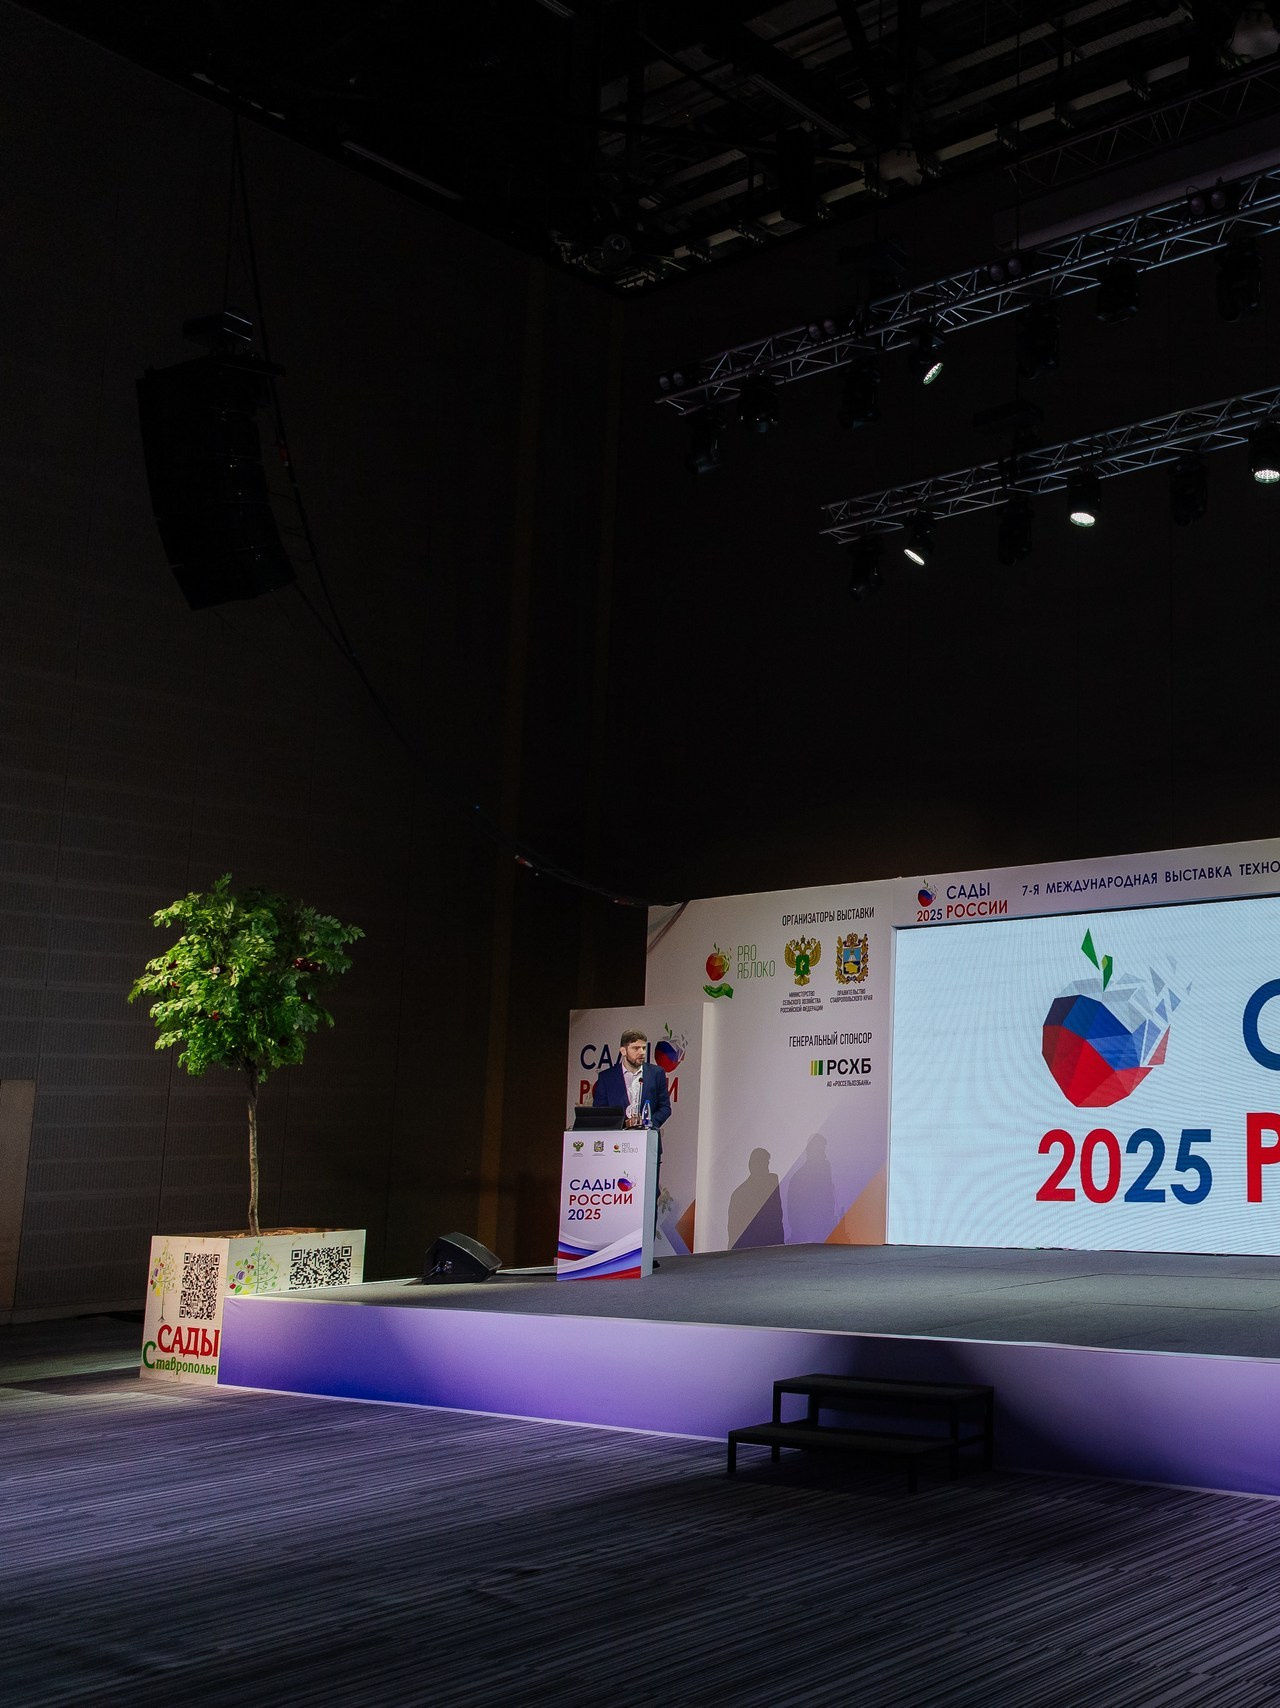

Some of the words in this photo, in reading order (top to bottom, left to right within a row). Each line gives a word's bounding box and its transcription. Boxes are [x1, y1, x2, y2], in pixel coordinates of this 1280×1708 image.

[1021, 884, 1040, 897] 7-Я
[1046, 872, 1158, 894] МЕЖДУНАРОДНАЯ
[1164, 864, 1233, 883] ВЫСТАВКА
[946, 882, 991, 900] САДЫ
[782, 911, 835, 926] ОРГАНИЗАТОРЫ
[837, 907, 875, 921] ВЫСТАВКИ
[916, 909, 943, 923] 2025
[946, 899, 1008, 919] РОССИИ
[737, 944, 757, 962] PRO
[737, 960, 776, 979] ЯБЛОКО
[789, 1031, 838, 1047] ГЕНЕРАЛЬНЫЙ
[840, 1032, 872, 1044] СПОНСОР
[827, 1058, 872, 1075] РСХБ
[1036, 1128, 1213, 1205] 2025
[569, 1179, 615, 1191] САДЫ
[569, 1193, 632, 1206] РОССИИ
[568, 1208, 601, 1220] 2025
[157, 1324, 221, 1359] САДЫ
[142, 1340, 217, 1376] Ставрополья
